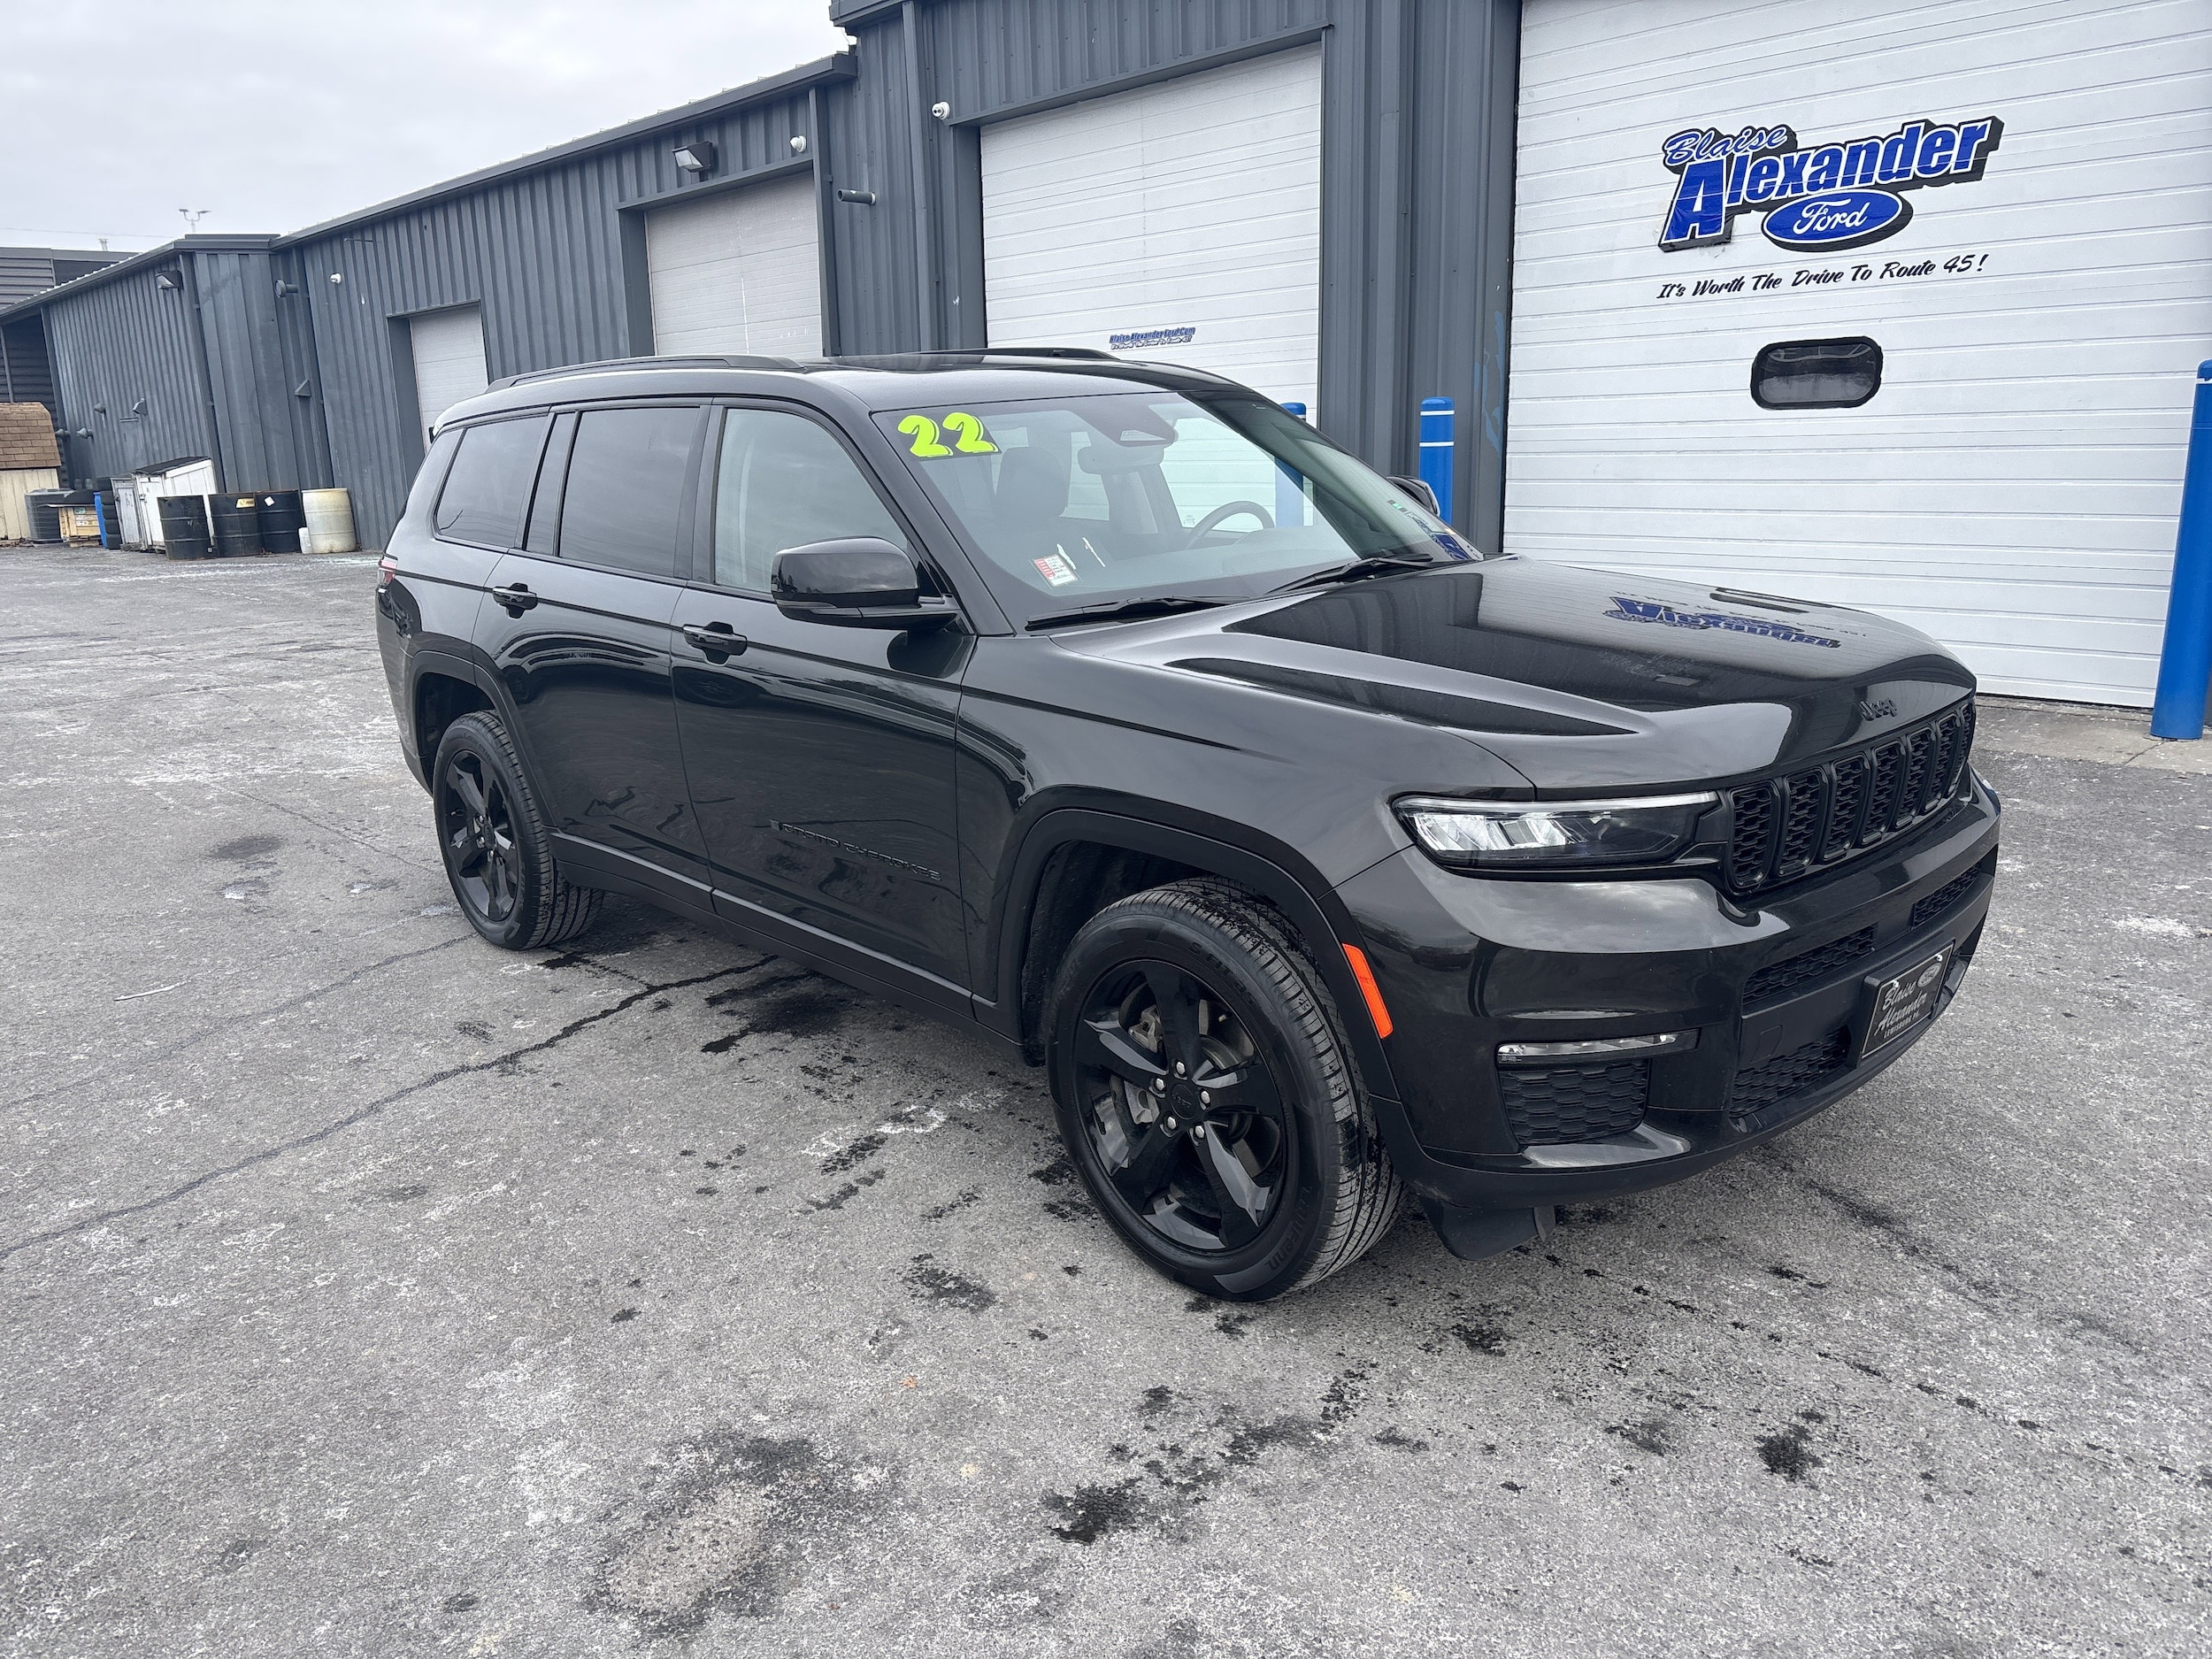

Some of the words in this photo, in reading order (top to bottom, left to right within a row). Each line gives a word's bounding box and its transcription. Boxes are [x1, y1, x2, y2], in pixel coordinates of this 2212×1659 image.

[1663, 125, 1791, 166] Blaise
[1659, 116, 1998, 248] Alexander
[1792, 198, 1868, 235] Ford
[1656, 282, 1686, 299] It's
[1692, 276, 1744, 298] Worth
[1751, 273, 1784, 291] The
[1792, 267, 1844, 286] Drive
[1850, 264, 1873, 282] To
[1883, 259, 1937, 279] Route
[897, 411, 998, 457] 22
[1859, 698, 1898, 722] Jeep
[782, 823, 841, 848] GRAND
[843, 842, 942, 881] CHEROKEE
[1873, 990, 1928, 1037] Alexander
[1882, 981, 1917, 1011] Blaise
